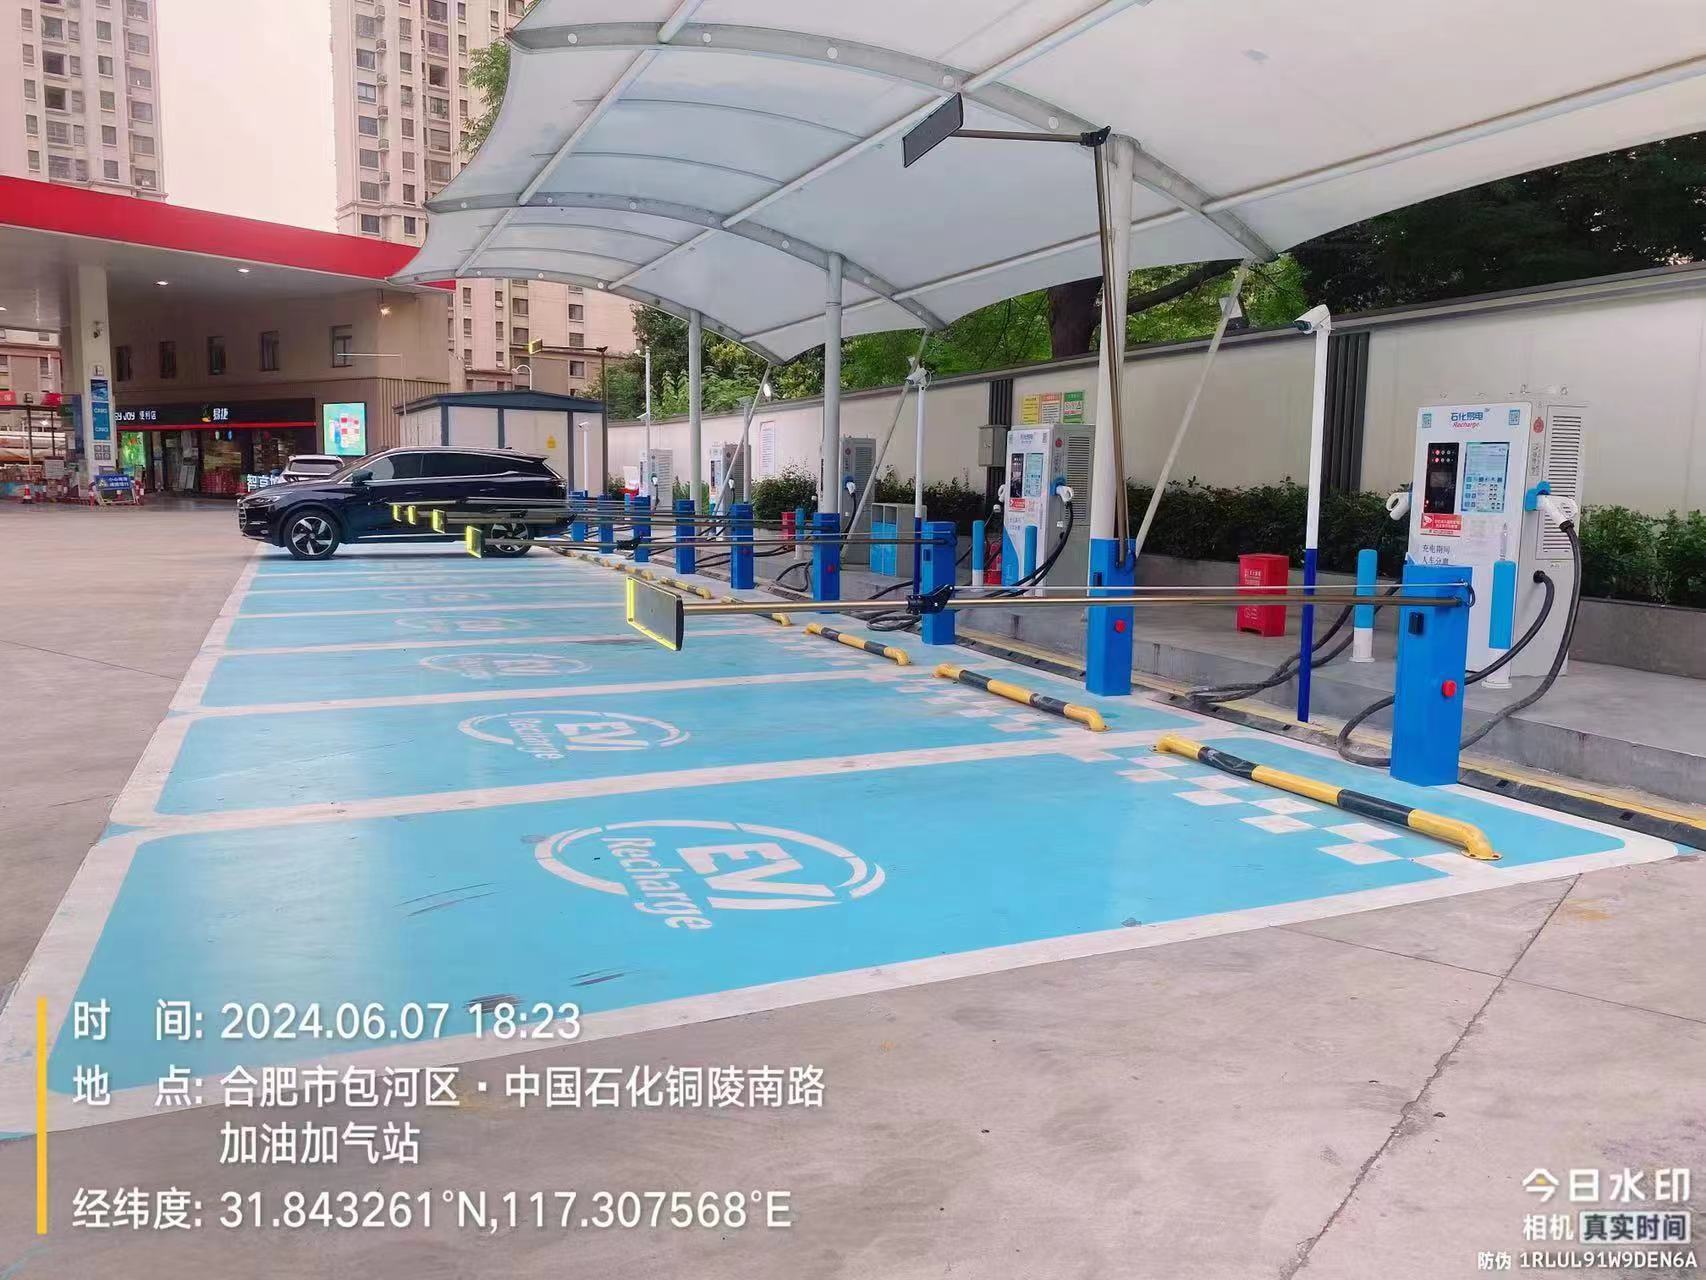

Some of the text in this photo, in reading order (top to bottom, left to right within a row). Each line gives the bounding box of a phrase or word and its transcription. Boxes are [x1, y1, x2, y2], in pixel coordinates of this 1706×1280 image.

[1452, 421, 1480, 430] Recharge
[601, 838, 713, 930] Recharge
[676, 843, 836, 898] EV
